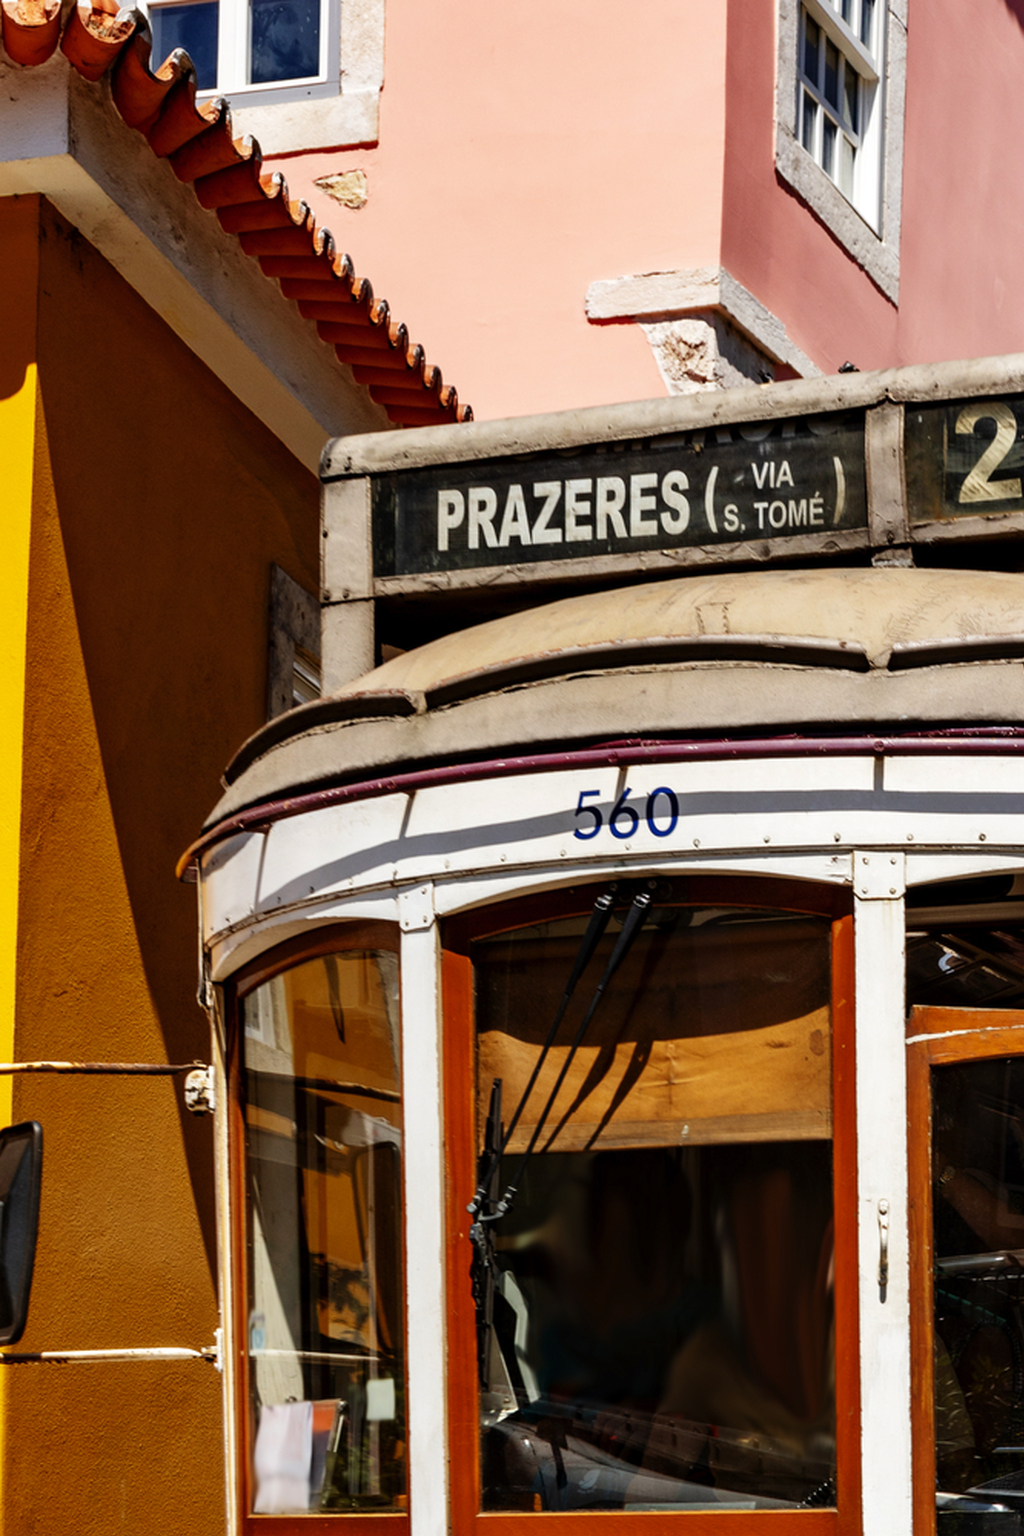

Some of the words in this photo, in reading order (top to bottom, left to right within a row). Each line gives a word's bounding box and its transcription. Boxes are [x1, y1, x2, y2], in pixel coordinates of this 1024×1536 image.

[437, 469, 691, 552] PRAZERES
[751, 460, 795, 490] VIA
[753, 490, 825, 530] TOMÉ
[573, 786, 680, 840] 560
